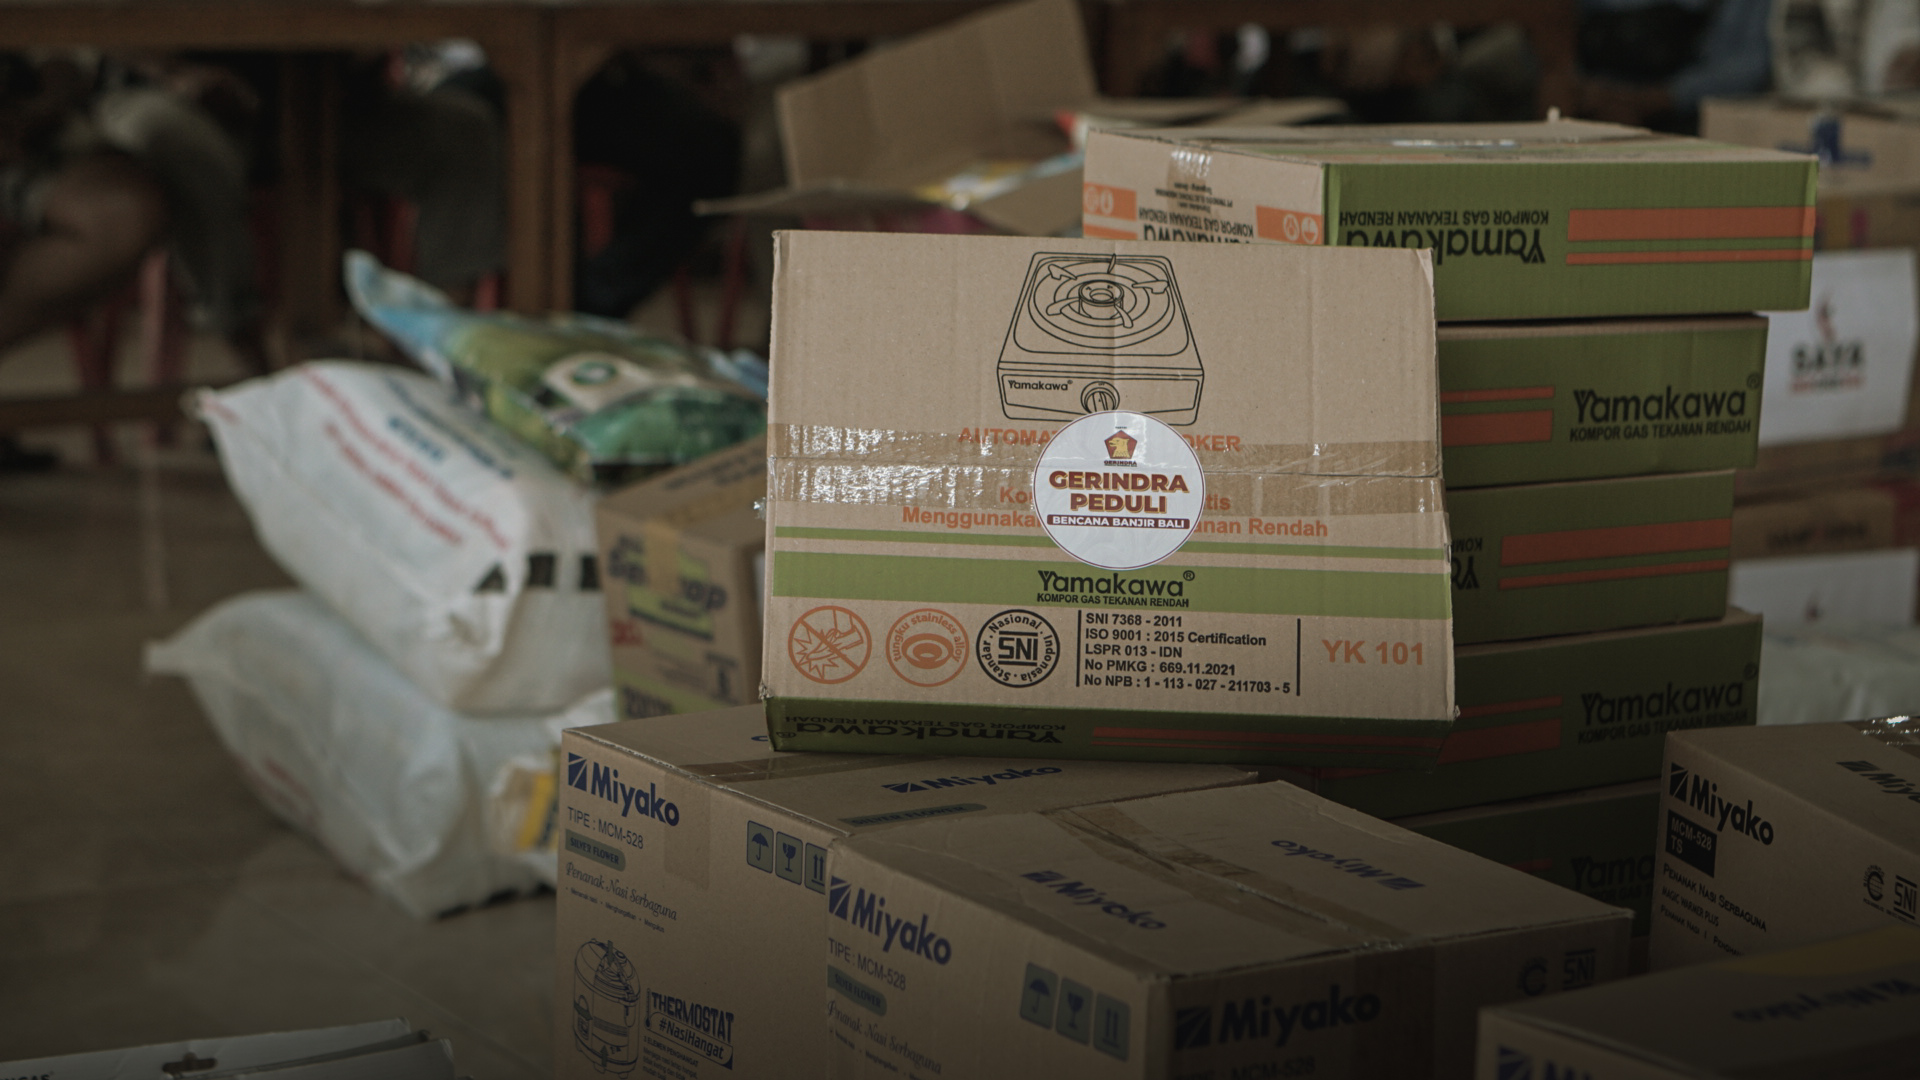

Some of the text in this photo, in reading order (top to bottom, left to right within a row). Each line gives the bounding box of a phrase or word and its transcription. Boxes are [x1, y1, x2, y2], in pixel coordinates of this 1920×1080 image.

[1138, 206, 1168, 222] RENDAH
[1169, 212, 1202, 229] TEKANAN
[1203, 216, 1220, 231] GAS
[1339, 210, 1548, 226] KOMPOR GAS TEKANAN RENDAH
[1221, 219, 1254, 238] KOMPOR
[1569, 419, 1751, 442] KOMPOR GAS TEKANAN RENDAH
[1049, 470, 1190, 494] GERINDRA
[1069, 493, 1167, 514] PEDULI
[1052, 515, 1185, 529] BENCANA BANJIR BALI
[1248, 518, 1328, 538] Rendah
[1036, 592, 1190, 608] KOMPOR GAS TEKANAN RENDAH
[988, 614, 1042, 634] Nasional
[1086, 612, 1108, 625] SNI
[1112, 613, 1142, 626] 7368
[1153, 615, 1183, 627] 2011
[997, 636, 1039, 661] SNI
[1085, 628, 1109, 640] ISO
[1112, 629, 1142, 641] 9001
[1154, 630, 1185, 643] 2015
[1187, 631, 1267, 647] Certification
[1085, 643, 1121, 656] LSPR
[1124, 644, 1148, 657] 013
[1159, 646, 1183, 658] IDN
[1321, 639, 1425, 667] YK 101
[1084, 659, 1103, 671] No
[1106, 660, 1147, 672] PMKG
[1159, 661, 1236, 676] 669.11.2021
[1084, 674, 1102, 686] No
[1104, 675, 1133, 687] NPB
[1144, 677, 1150, 688] 1
[1163, 678, 1184, 689] 113
[1195, 679, 1217, 691] 027
[1228, 680, 1272, 692] 211703
[1283, 682, 1290, 694] 5
[785, 716, 1066, 731] KOMPOR GAS TEKANAN RENDAH
[1578, 710, 1749, 745] KOMPOR GAS TEKANAN RENDAH
[920, 766, 1063, 790] Miyako
[591, 761, 680, 827] Miyako
[850, 805, 966, 826] SILVER FLOWER
[1690, 773, 1775, 846] Miyako
[567, 806, 590, 829] TIPE
[598, 818, 645, 850] MCM-528
[1671, 816, 1713, 851] MCM-528
[570, 836, 620, 865] SILVER FLOWER
[1670, 834, 1684, 855] TS
[1271, 839, 1394, 880] Miyako
[565, 861, 678, 921] Penanak Nasi Serbaguna
[1893, 881, 1918, 914] SNI
[1048, 881, 1167, 931] Miyako
[851, 888, 952, 966] Miyako
[1704, 910, 1720, 927] PLUS
[828, 937, 851, 965] TIPE
[857, 953, 907, 991] MCM-528
[1562, 954, 1597, 985] SNI
[834, 972, 882, 1008] SILVER FLOWER
[651, 991, 735, 1044] THERMOSTAT
[1218, 984, 1382, 1048] Miyako
[658, 1017, 725, 1060] #NasiHangat
[864, 1022, 888, 1048] Nasi
[888, 1034, 942, 1076] Serbaguna
